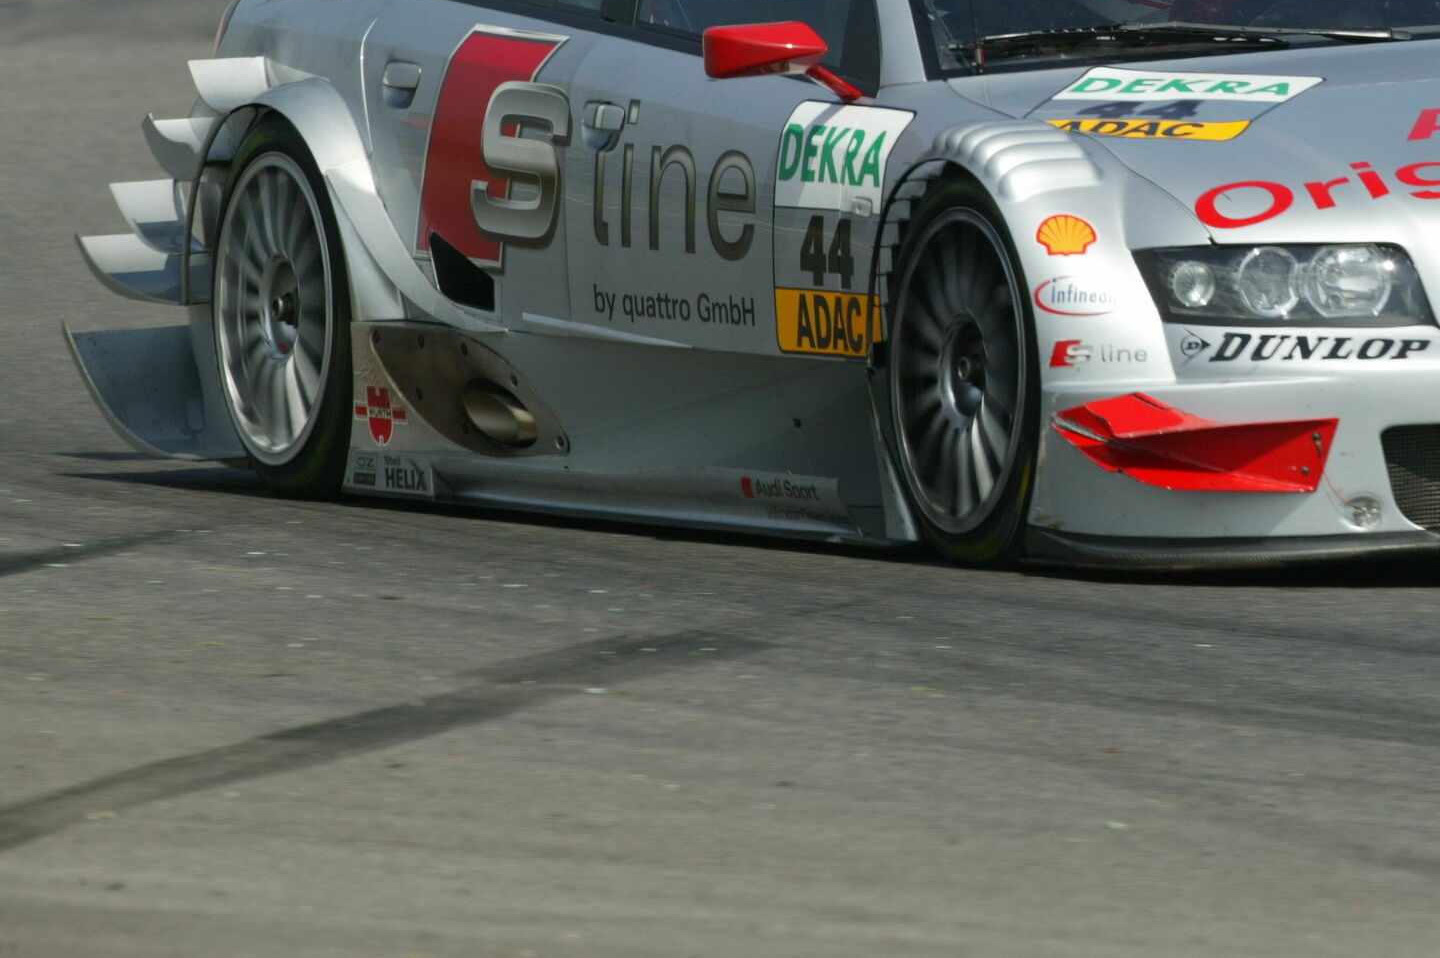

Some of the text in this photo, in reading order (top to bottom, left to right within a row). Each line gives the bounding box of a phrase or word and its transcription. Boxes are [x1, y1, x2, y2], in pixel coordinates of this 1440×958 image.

[1069, 77, 1290, 96] DEKRA
[1075, 100, 1205, 120] 44
[1059, 121, 1205, 137] ADAC
[778, 123, 889, 188] DEKRA
[799, 215, 854, 289] 44
[593, 283, 756, 327] by quattro GmbH
[796, 293, 864, 352] ADAC
[1101, 344, 1148, 363] line
[1209, 332, 1431, 362] DUNLOP
[385, 467, 427, 491] HELIX
[756, 479, 819, 501] Audi Sport
